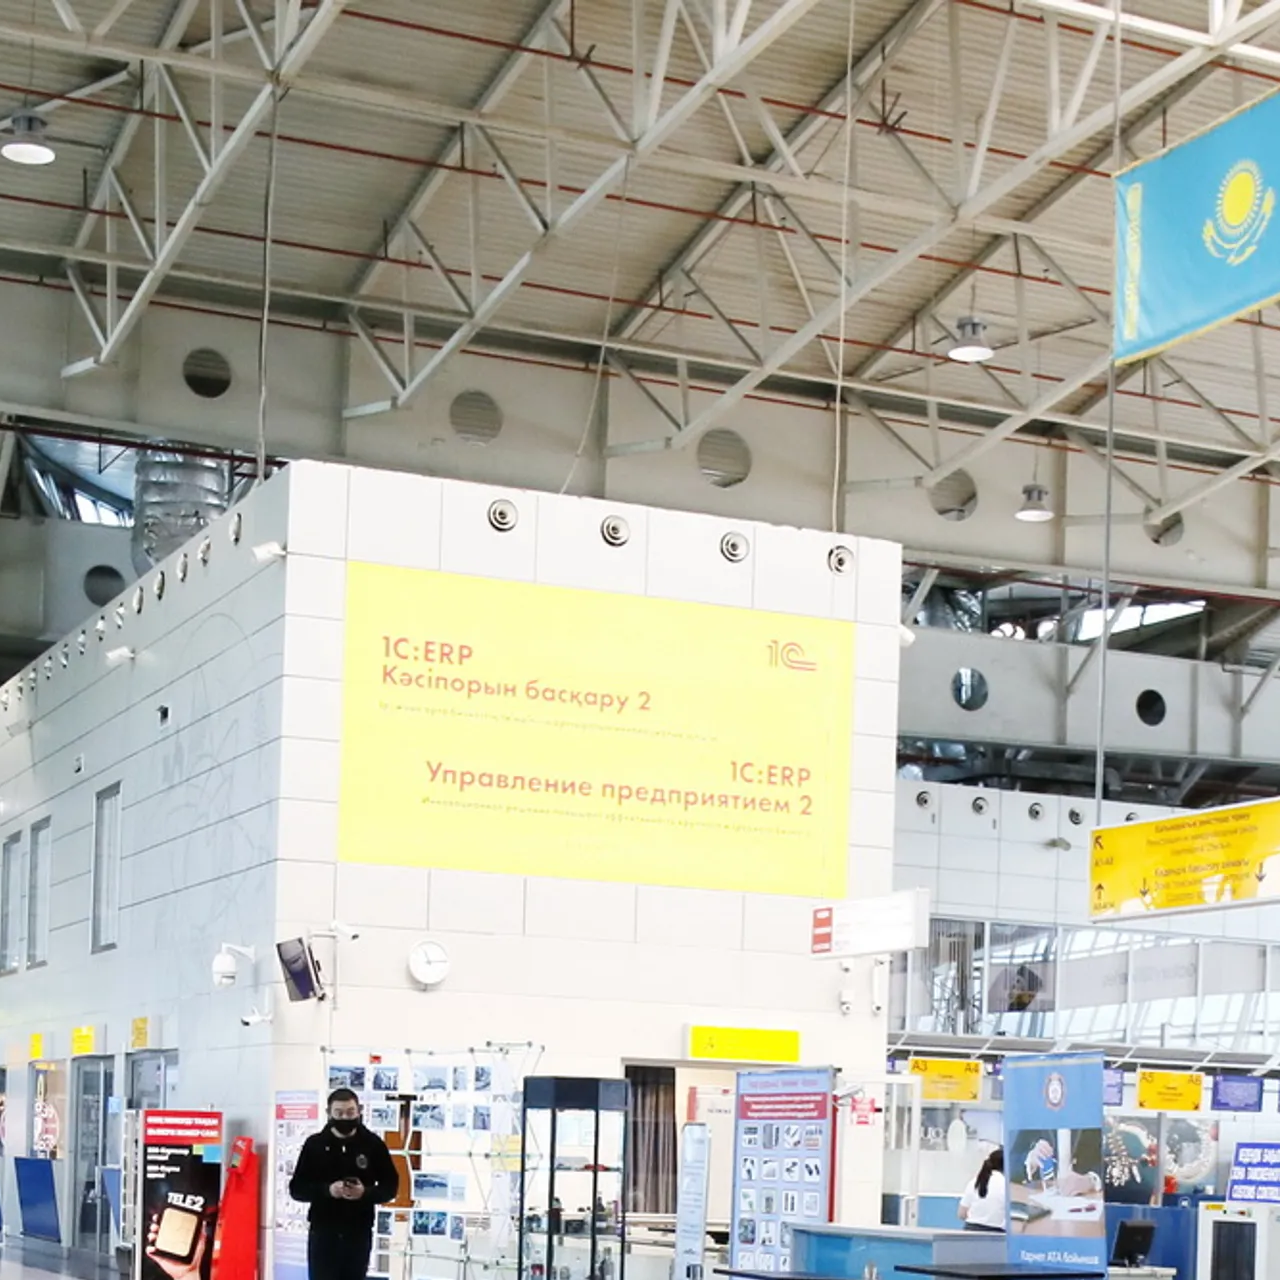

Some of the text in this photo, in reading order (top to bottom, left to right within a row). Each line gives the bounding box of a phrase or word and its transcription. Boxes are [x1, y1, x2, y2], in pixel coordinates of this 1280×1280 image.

[382, 636, 474, 666] 1C:ERP
[382, 664, 652, 715] Кәсіпорын басқару 2
[425, 760, 813, 816] Управление предприятием 2
[731, 760, 811, 788] 1C:ERP
[911, 1060, 928, 1072] A3
[167, 1191, 205, 1212] TELE2
